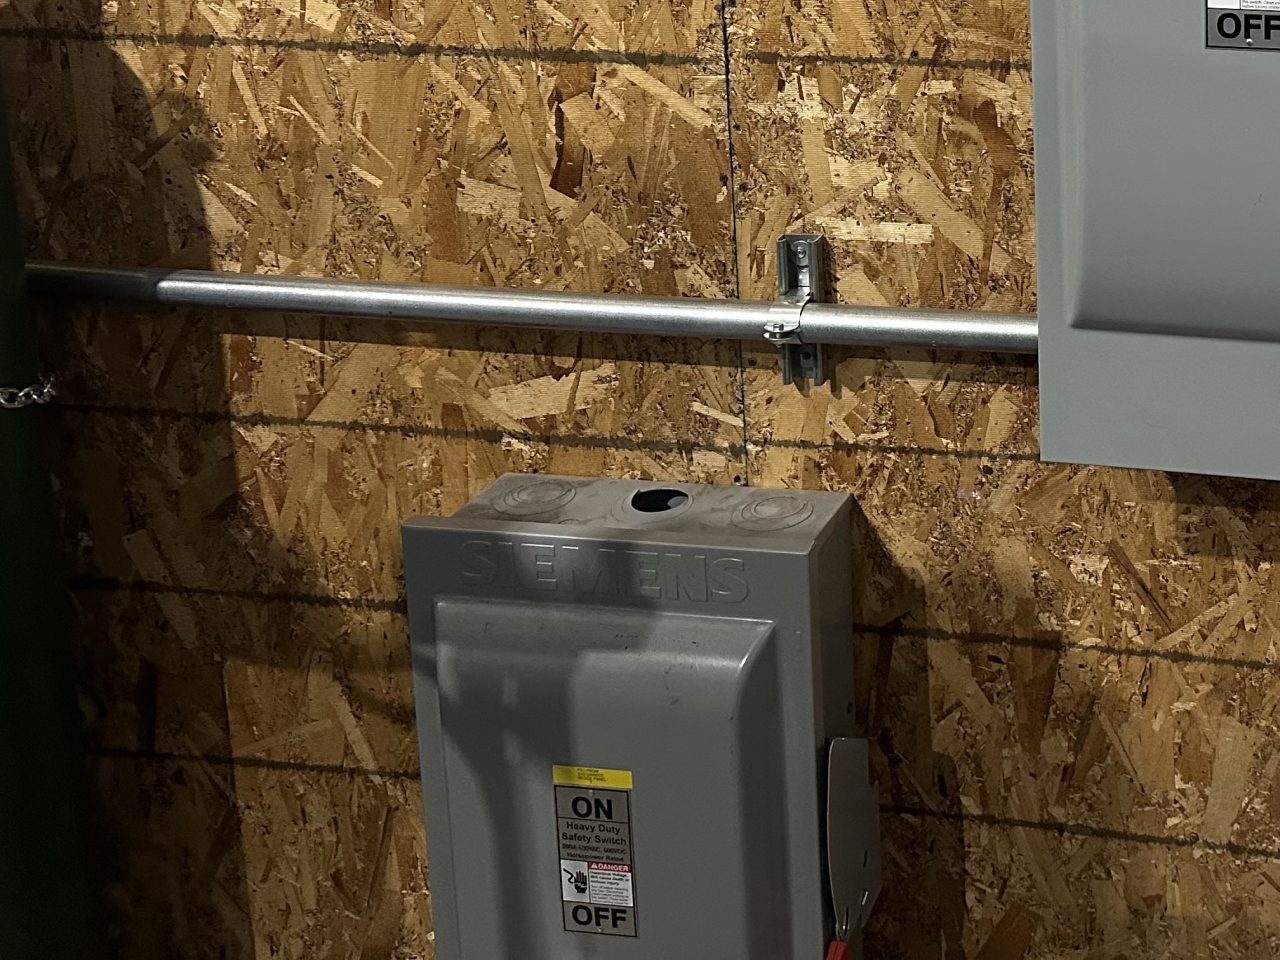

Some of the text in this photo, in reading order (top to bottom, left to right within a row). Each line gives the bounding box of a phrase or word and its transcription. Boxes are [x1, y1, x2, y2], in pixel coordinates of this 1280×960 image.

[461, 540, 750, 604] SIEMENS
[571, 796, 613, 820] ON
[566, 821, 621, 835] Heavy Duty
[562, 832, 627, 845] Safety Switch
[598, 863, 629, 872] DANGER
[571, 904, 627, 929] OFF
